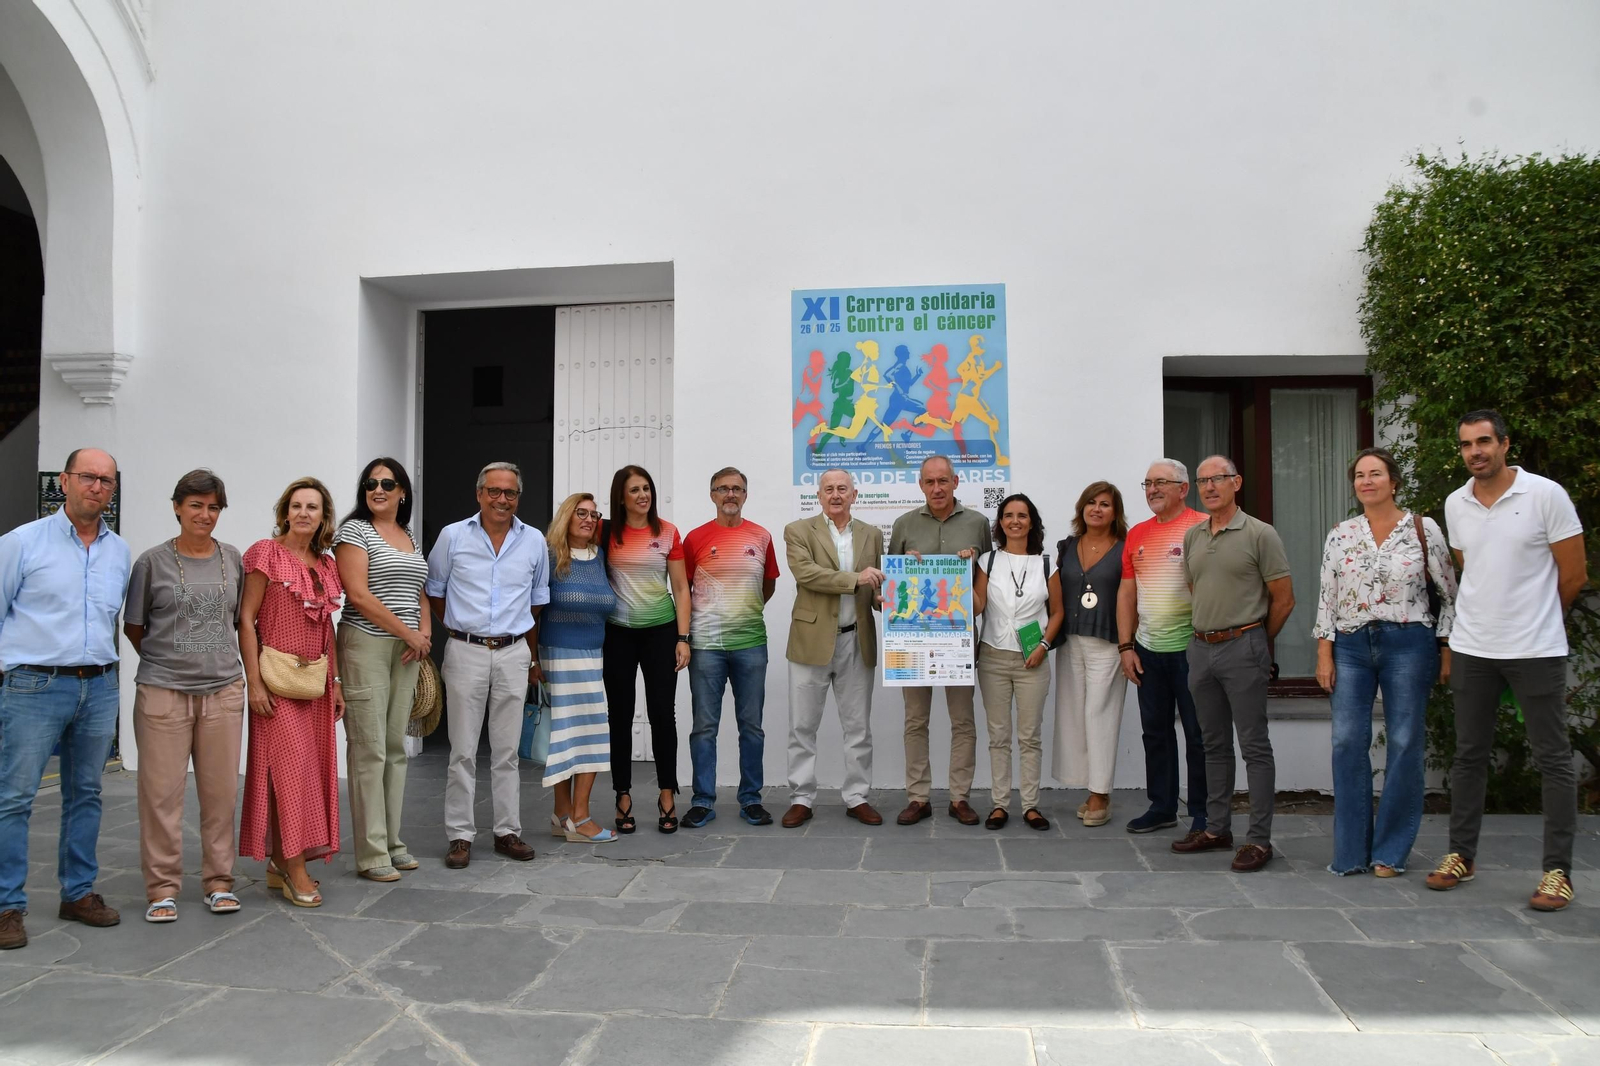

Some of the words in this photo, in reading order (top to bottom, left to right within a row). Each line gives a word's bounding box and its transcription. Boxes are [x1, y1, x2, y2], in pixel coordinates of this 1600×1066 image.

[846, 295, 914, 313] Carrera
[921, 291, 996, 311] solidaria
[800, 296, 840, 321] XI
[847, 315, 904, 333] Contra
[914, 313, 928, 331] el
[937, 312, 996, 331] cáncer
[881, 470, 906, 484] DE
[911, 469, 1005, 483] TARES
[886, 558, 903, 568] XI
[936, 557, 967, 566] solidaria
[905, 566, 930, 575] Contra
[943, 566, 967, 575] cáncer
[931, 630, 970, 638] TOMARES
